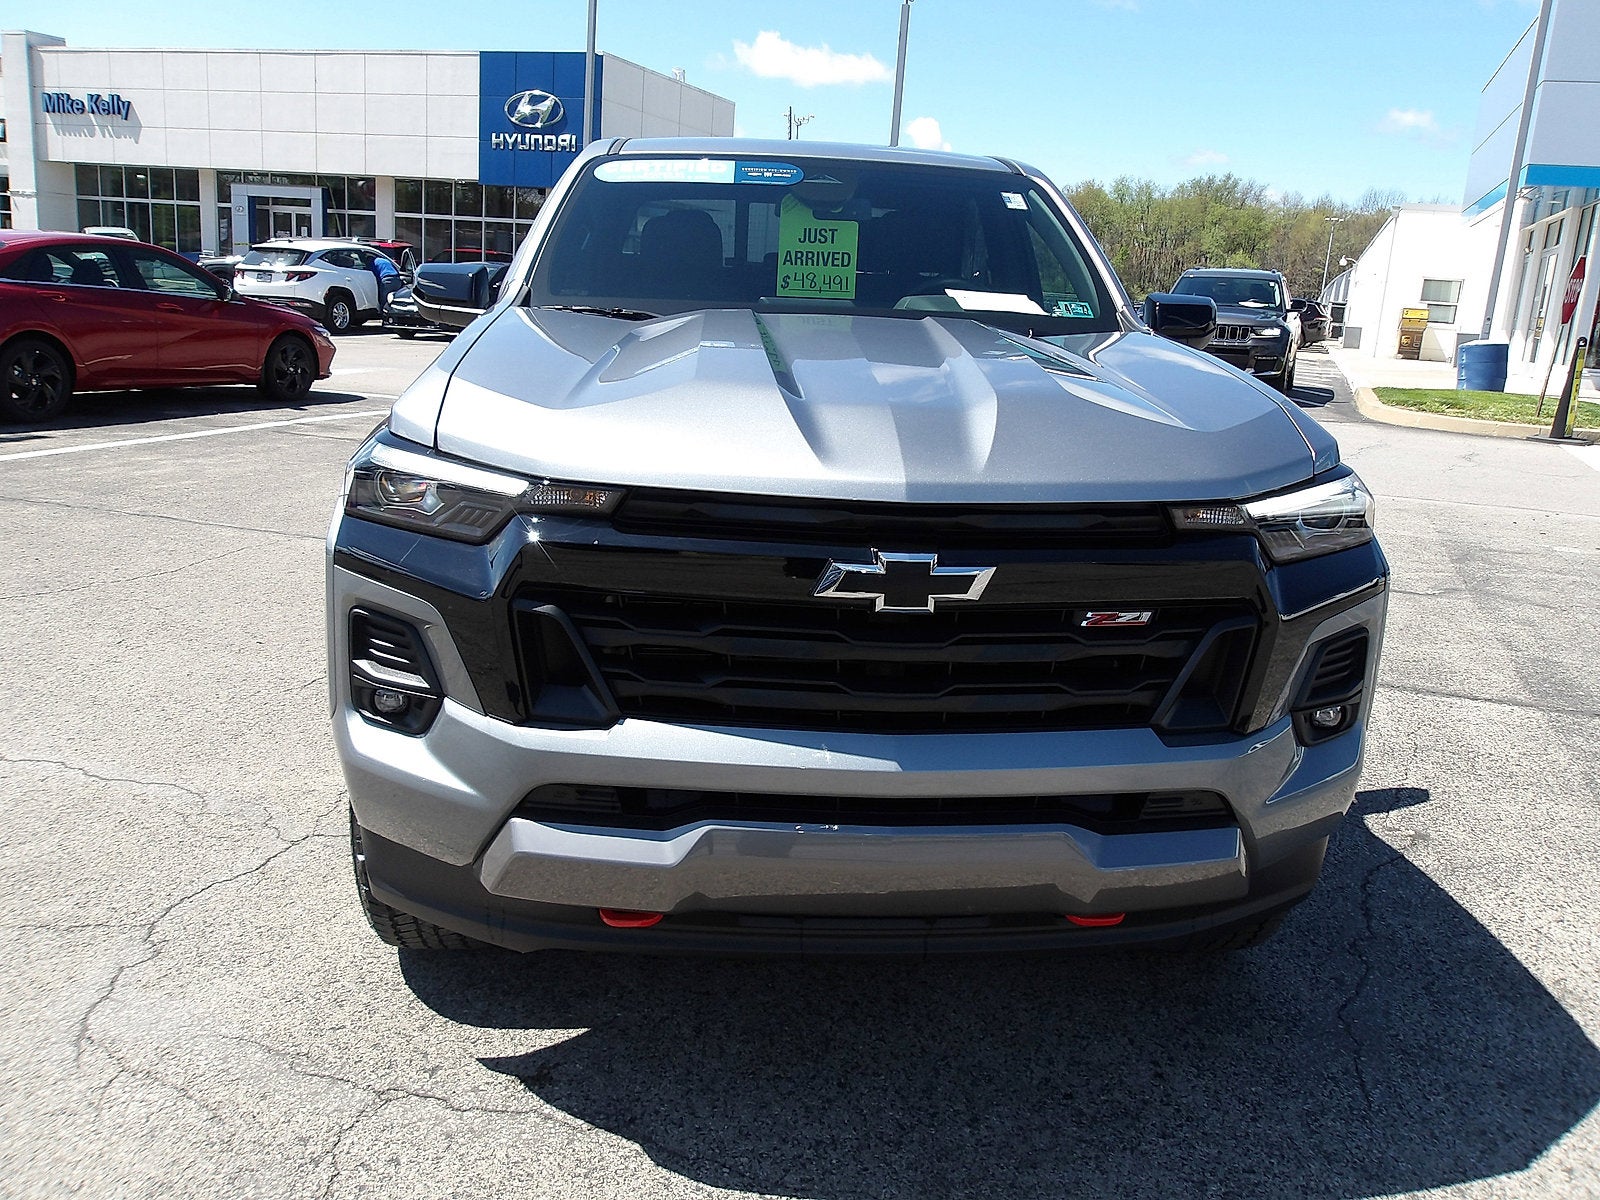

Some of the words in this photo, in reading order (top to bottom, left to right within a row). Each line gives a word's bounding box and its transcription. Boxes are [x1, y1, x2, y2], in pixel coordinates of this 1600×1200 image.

[42, 92, 86, 114] Mike
[87, 93, 131, 120] Kelly
[491, 132, 577, 153] HYUNDAI
[798, 228, 838, 244] JUST
[782, 250, 852, 268] ARRIVED
[780, 271, 850, 294] $48,491
[1080, 611, 1152, 627] Z71
